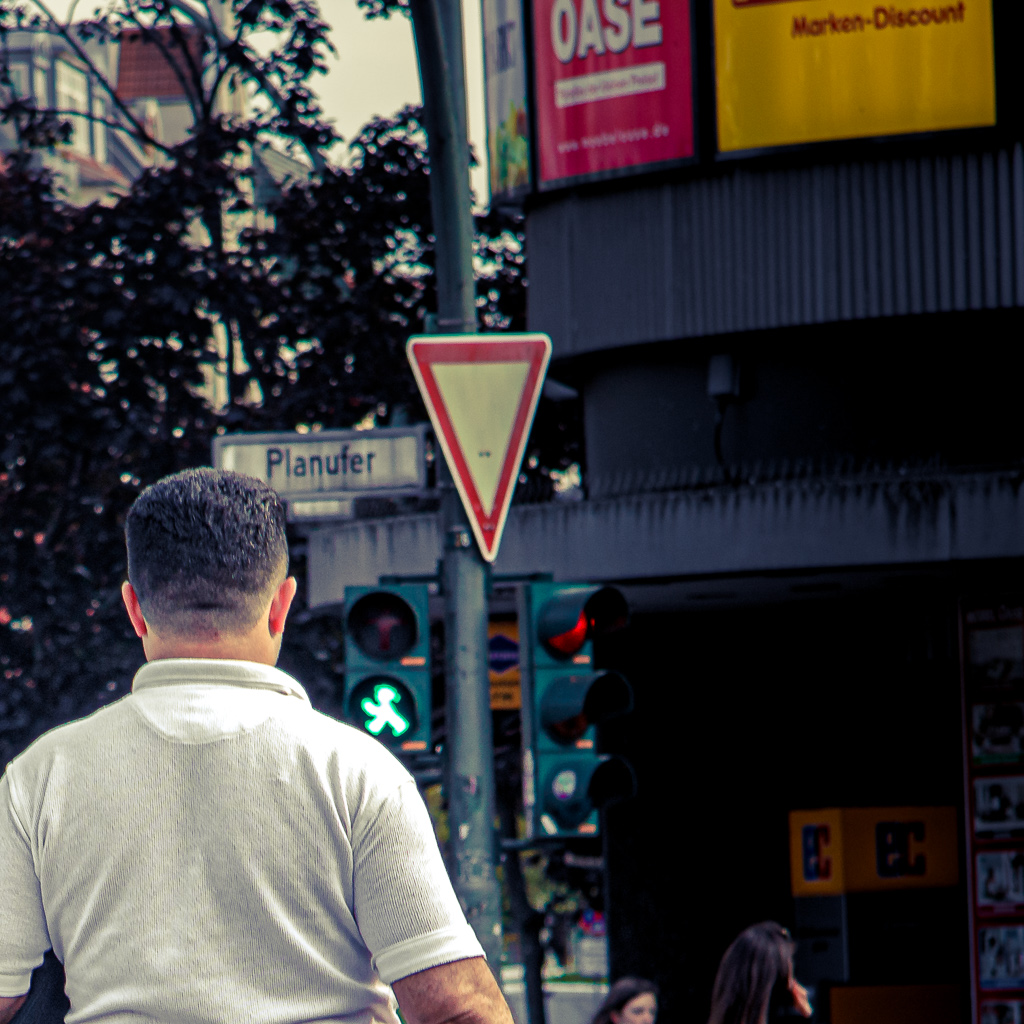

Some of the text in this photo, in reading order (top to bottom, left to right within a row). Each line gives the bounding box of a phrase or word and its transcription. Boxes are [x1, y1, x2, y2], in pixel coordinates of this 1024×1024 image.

[551, 0, 663, 64] OASE
[792, 2, 966, 38] Marken-Discount
[266, 444, 375, 479] Planufer
